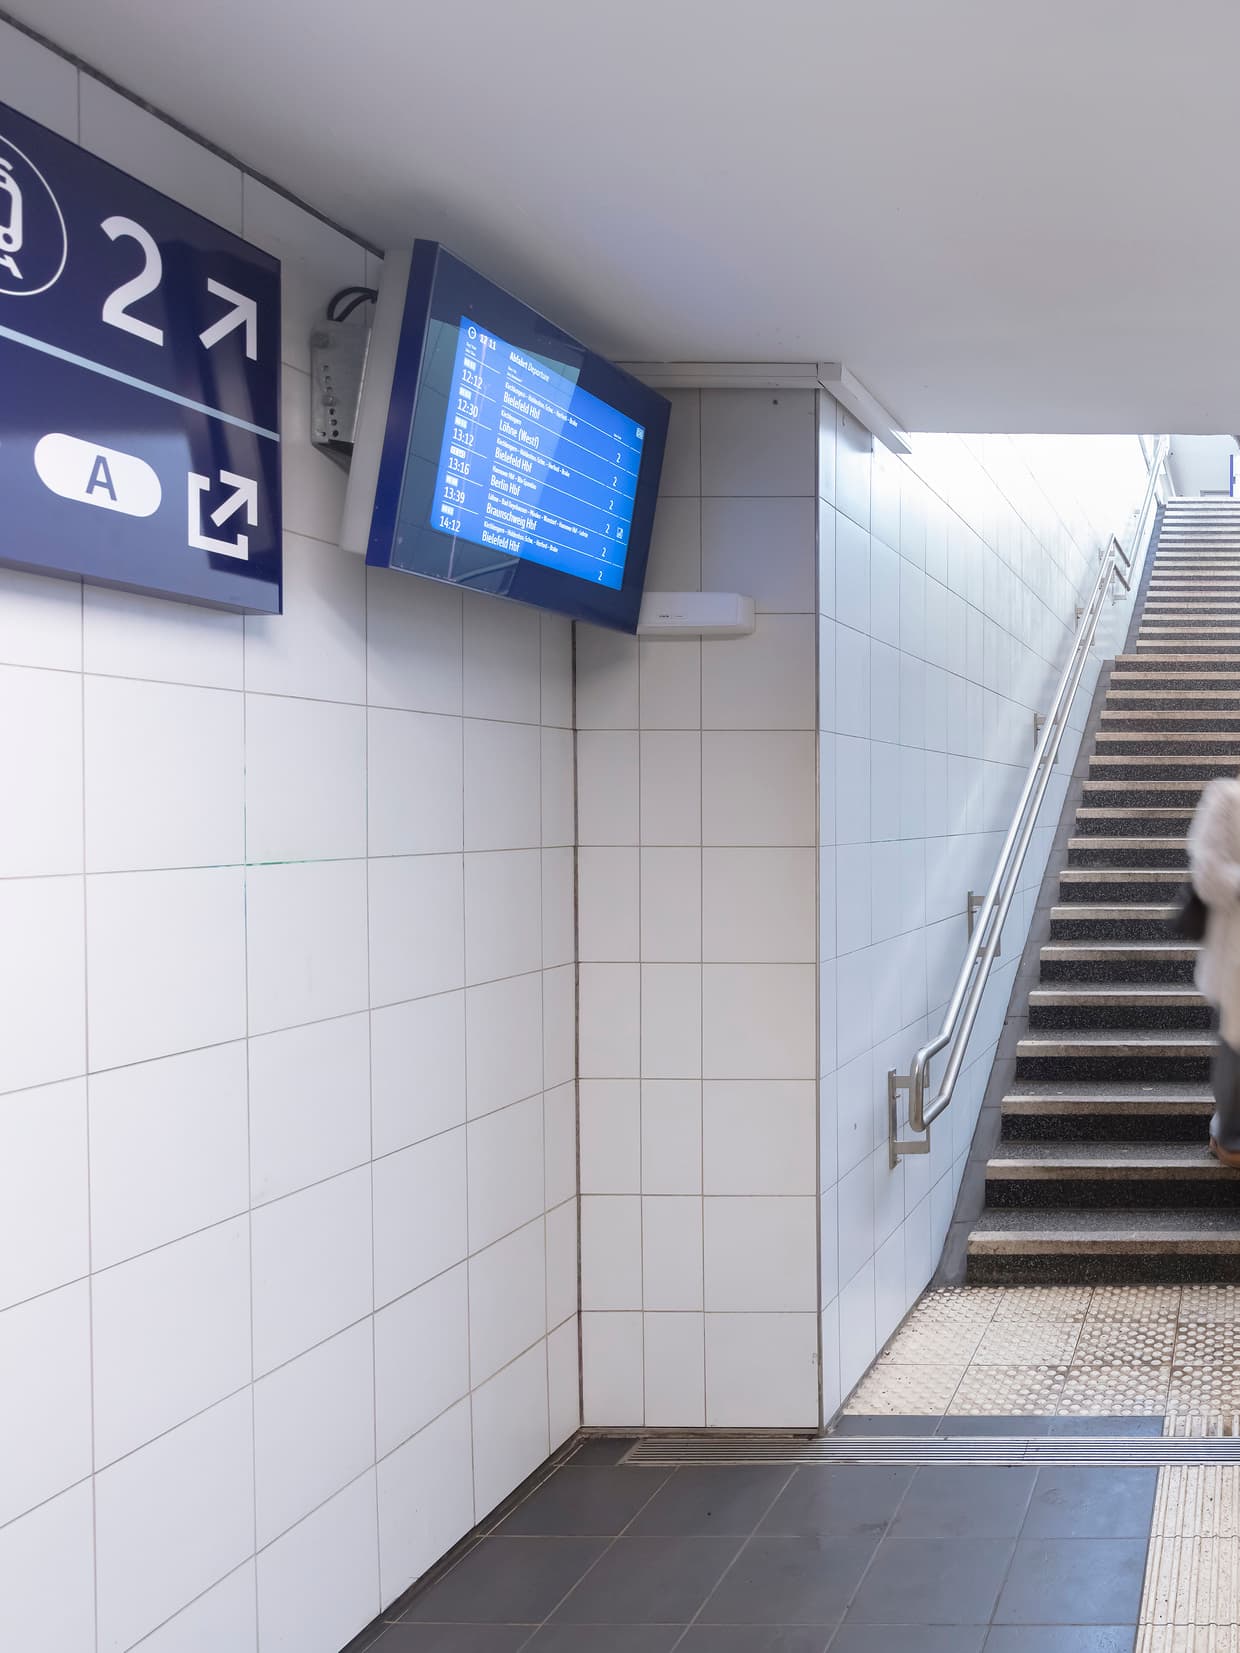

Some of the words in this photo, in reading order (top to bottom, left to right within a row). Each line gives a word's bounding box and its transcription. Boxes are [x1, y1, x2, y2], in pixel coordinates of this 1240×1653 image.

[101, 216, 163, 346] 2
[457, 398, 479, 418] 12:30
[499, 418, 518, 438] Löhne
[518, 428, 540, 449] (Westf)
[612, 476, 618, 487] 2
[462, 369, 483, 390] 12:12
[503, 391, 530, 414] Bielefeld
[529, 405, 541, 420] Hbf
[616, 452, 621, 464] 2
[86, 455, 117, 501] A
[448, 457, 470, 475] 13:16
[490, 474, 509, 492] Berlin
[509, 482, 521, 497] Hbf
[605, 523, 611, 534] 2
[452, 427, 475, 447] 13:12
[494, 446, 522, 470] Bielefeld
[521, 459, 533, 473] Hbf
[609, 500, 614, 511] 2
[439, 515, 461, 533] 14:12
[481, 530, 509, 549] Bielefeld
[508, 539, 521, 553] Hbf
[597, 570, 603, 581] 2
[443, 486, 465, 504] 13:39
[486, 502, 526, 529] Braunschweig
[525, 516, 538, 531] Hbf
[601, 547, 607, 558] 2
